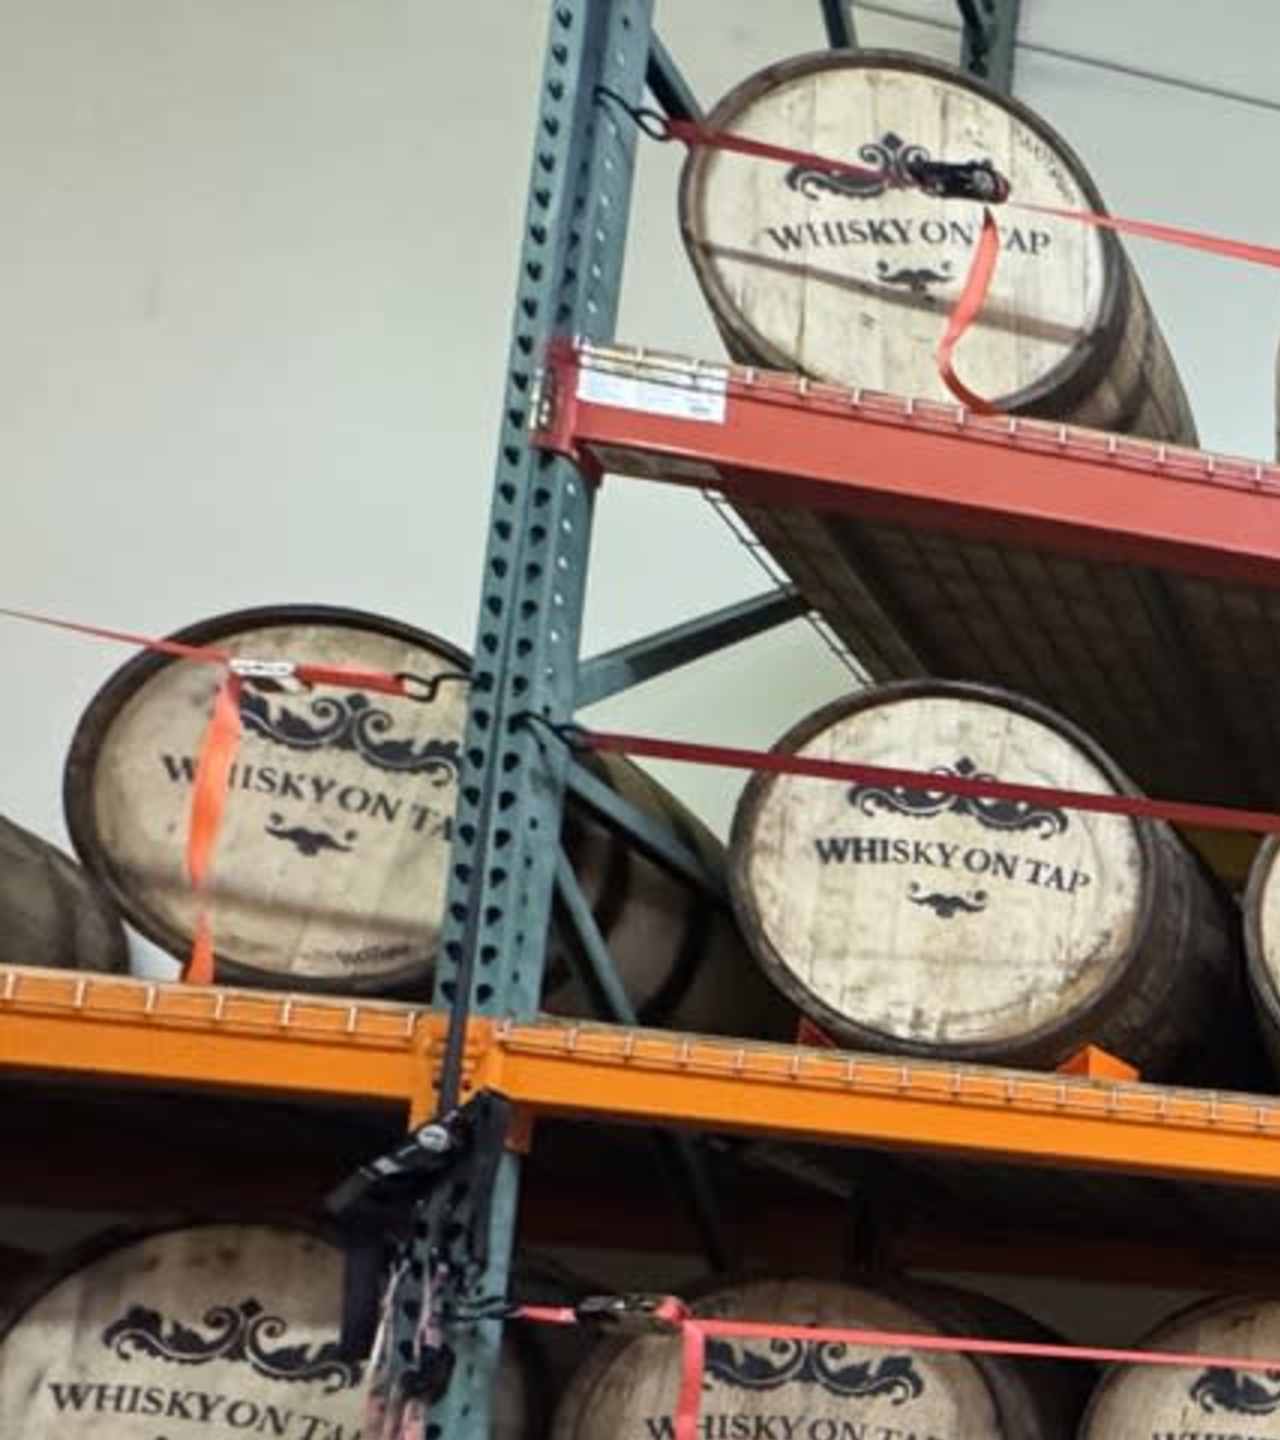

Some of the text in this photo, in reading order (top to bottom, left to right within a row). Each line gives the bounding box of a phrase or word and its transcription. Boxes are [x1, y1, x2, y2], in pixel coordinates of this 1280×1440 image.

[767, 220, 1050, 253] WHISKY ON AP
[337, 785, 403, 823] ON
[409, 801, 452, 842] TA
[813, 836, 1090, 895] WHISKY ON TAP
[49, 1382, 227, 1424] WHISKY
[225, 1396, 294, 1440] ON
